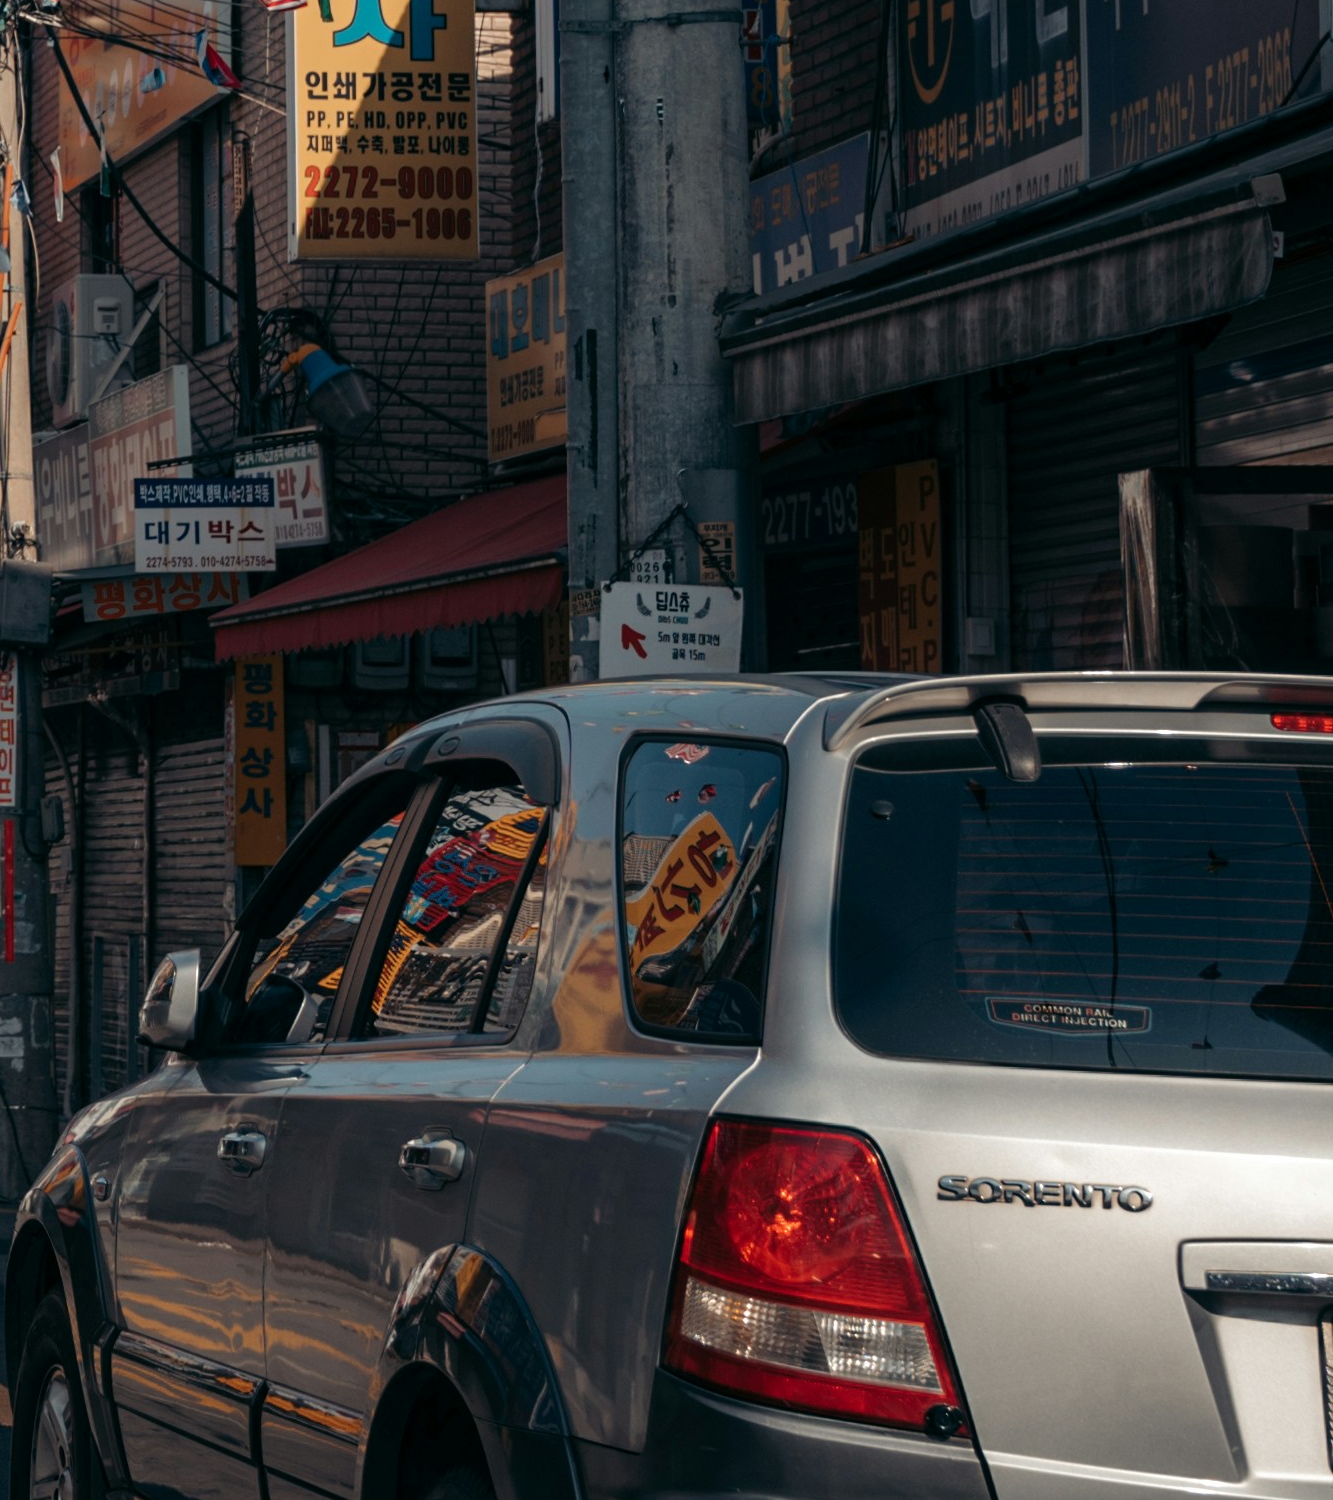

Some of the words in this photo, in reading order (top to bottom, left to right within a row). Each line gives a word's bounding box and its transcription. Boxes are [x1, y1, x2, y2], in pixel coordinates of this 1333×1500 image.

[305, 71, 471, 102] 인쇄가공전문
[436, 109, 468, 131] PVC
[305, 166, 473, 201] 2272-9000
[93, 573, 241, 620] 평화상사
[239, 662, 275, 821] 평화상사
[1012, 1013, 1056, 1023] DIRECT
[1061, 1015, 1127, 1029] INJECTION
[1024, 1003, 1081, 1015] COMMON
[938, 1176, 1151, 1212] SORENTO
